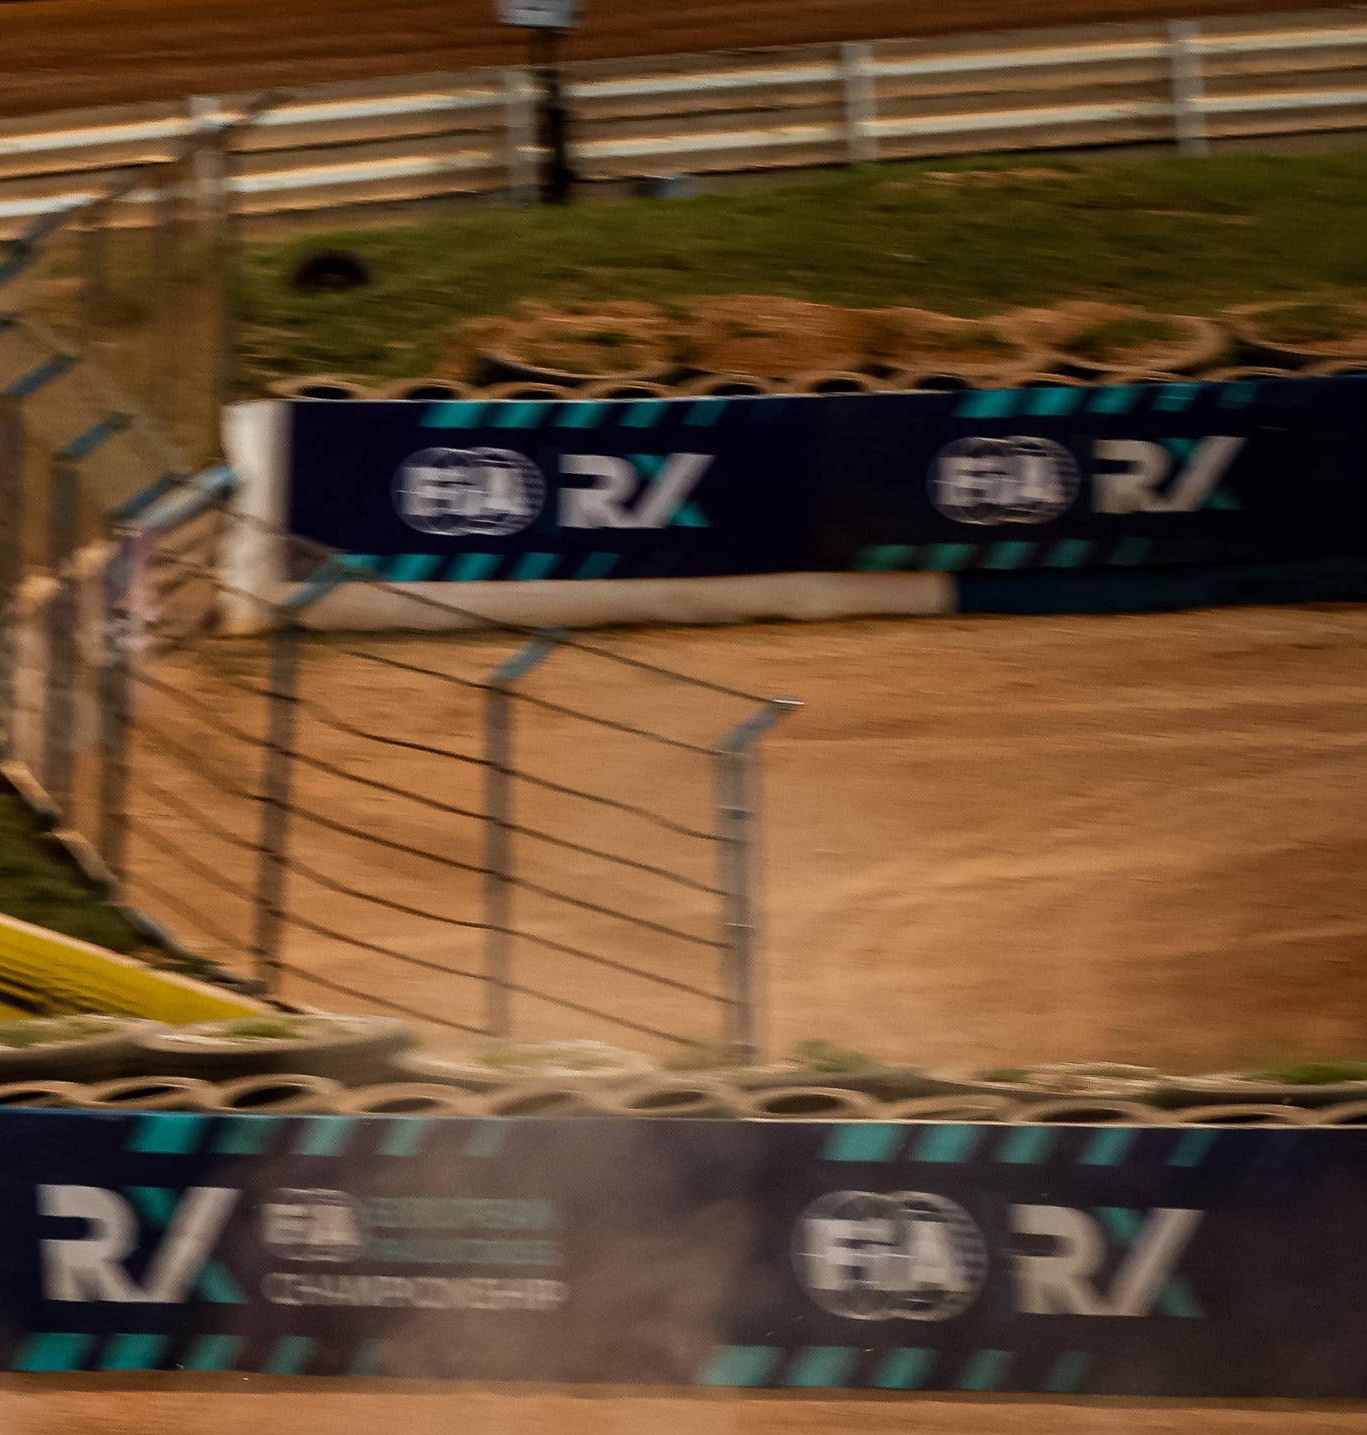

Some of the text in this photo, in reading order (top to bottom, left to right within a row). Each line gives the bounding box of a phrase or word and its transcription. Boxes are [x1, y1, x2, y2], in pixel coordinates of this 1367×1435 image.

[558, 452, 715, 528] RX
[1091, 435, 1248, 514] RX
[35, 1183, 248, 1304] RX
[804, 1203, 1207, 1320] FIA RX
